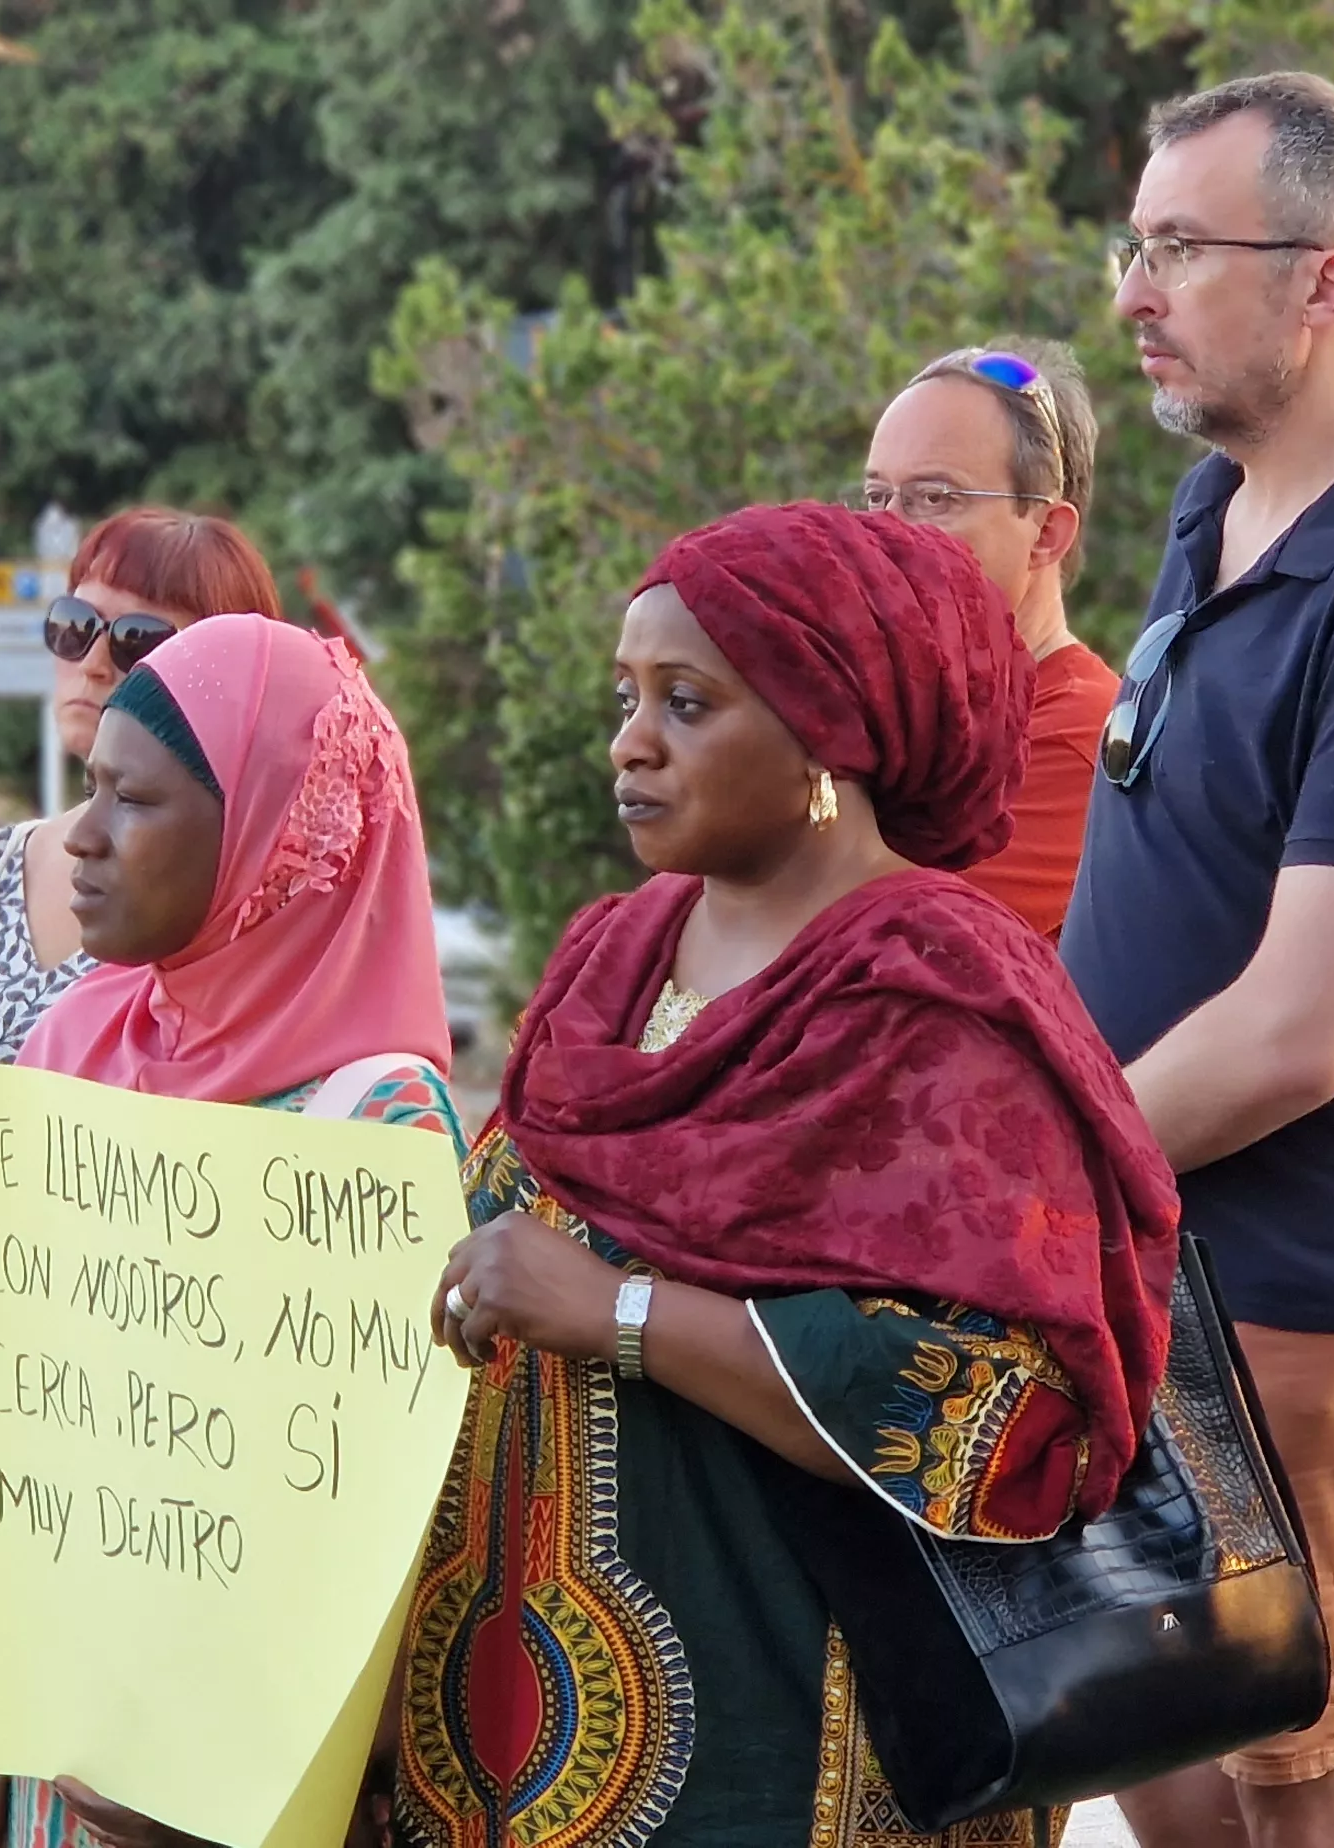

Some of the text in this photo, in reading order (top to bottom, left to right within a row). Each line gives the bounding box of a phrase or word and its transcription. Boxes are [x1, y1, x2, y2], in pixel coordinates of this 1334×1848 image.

[46, 1114, 221, 1246] LLEVAMOS
[262, 1153, 424, 1260] SIEMPRE
[70, 1254, 244, 1364] NOSOTROS,
[263, 1287, 335, 1366] NO
[349, 1298, 434, 1414] MUY
[95, 1485, 244, 1590] DENTRO
